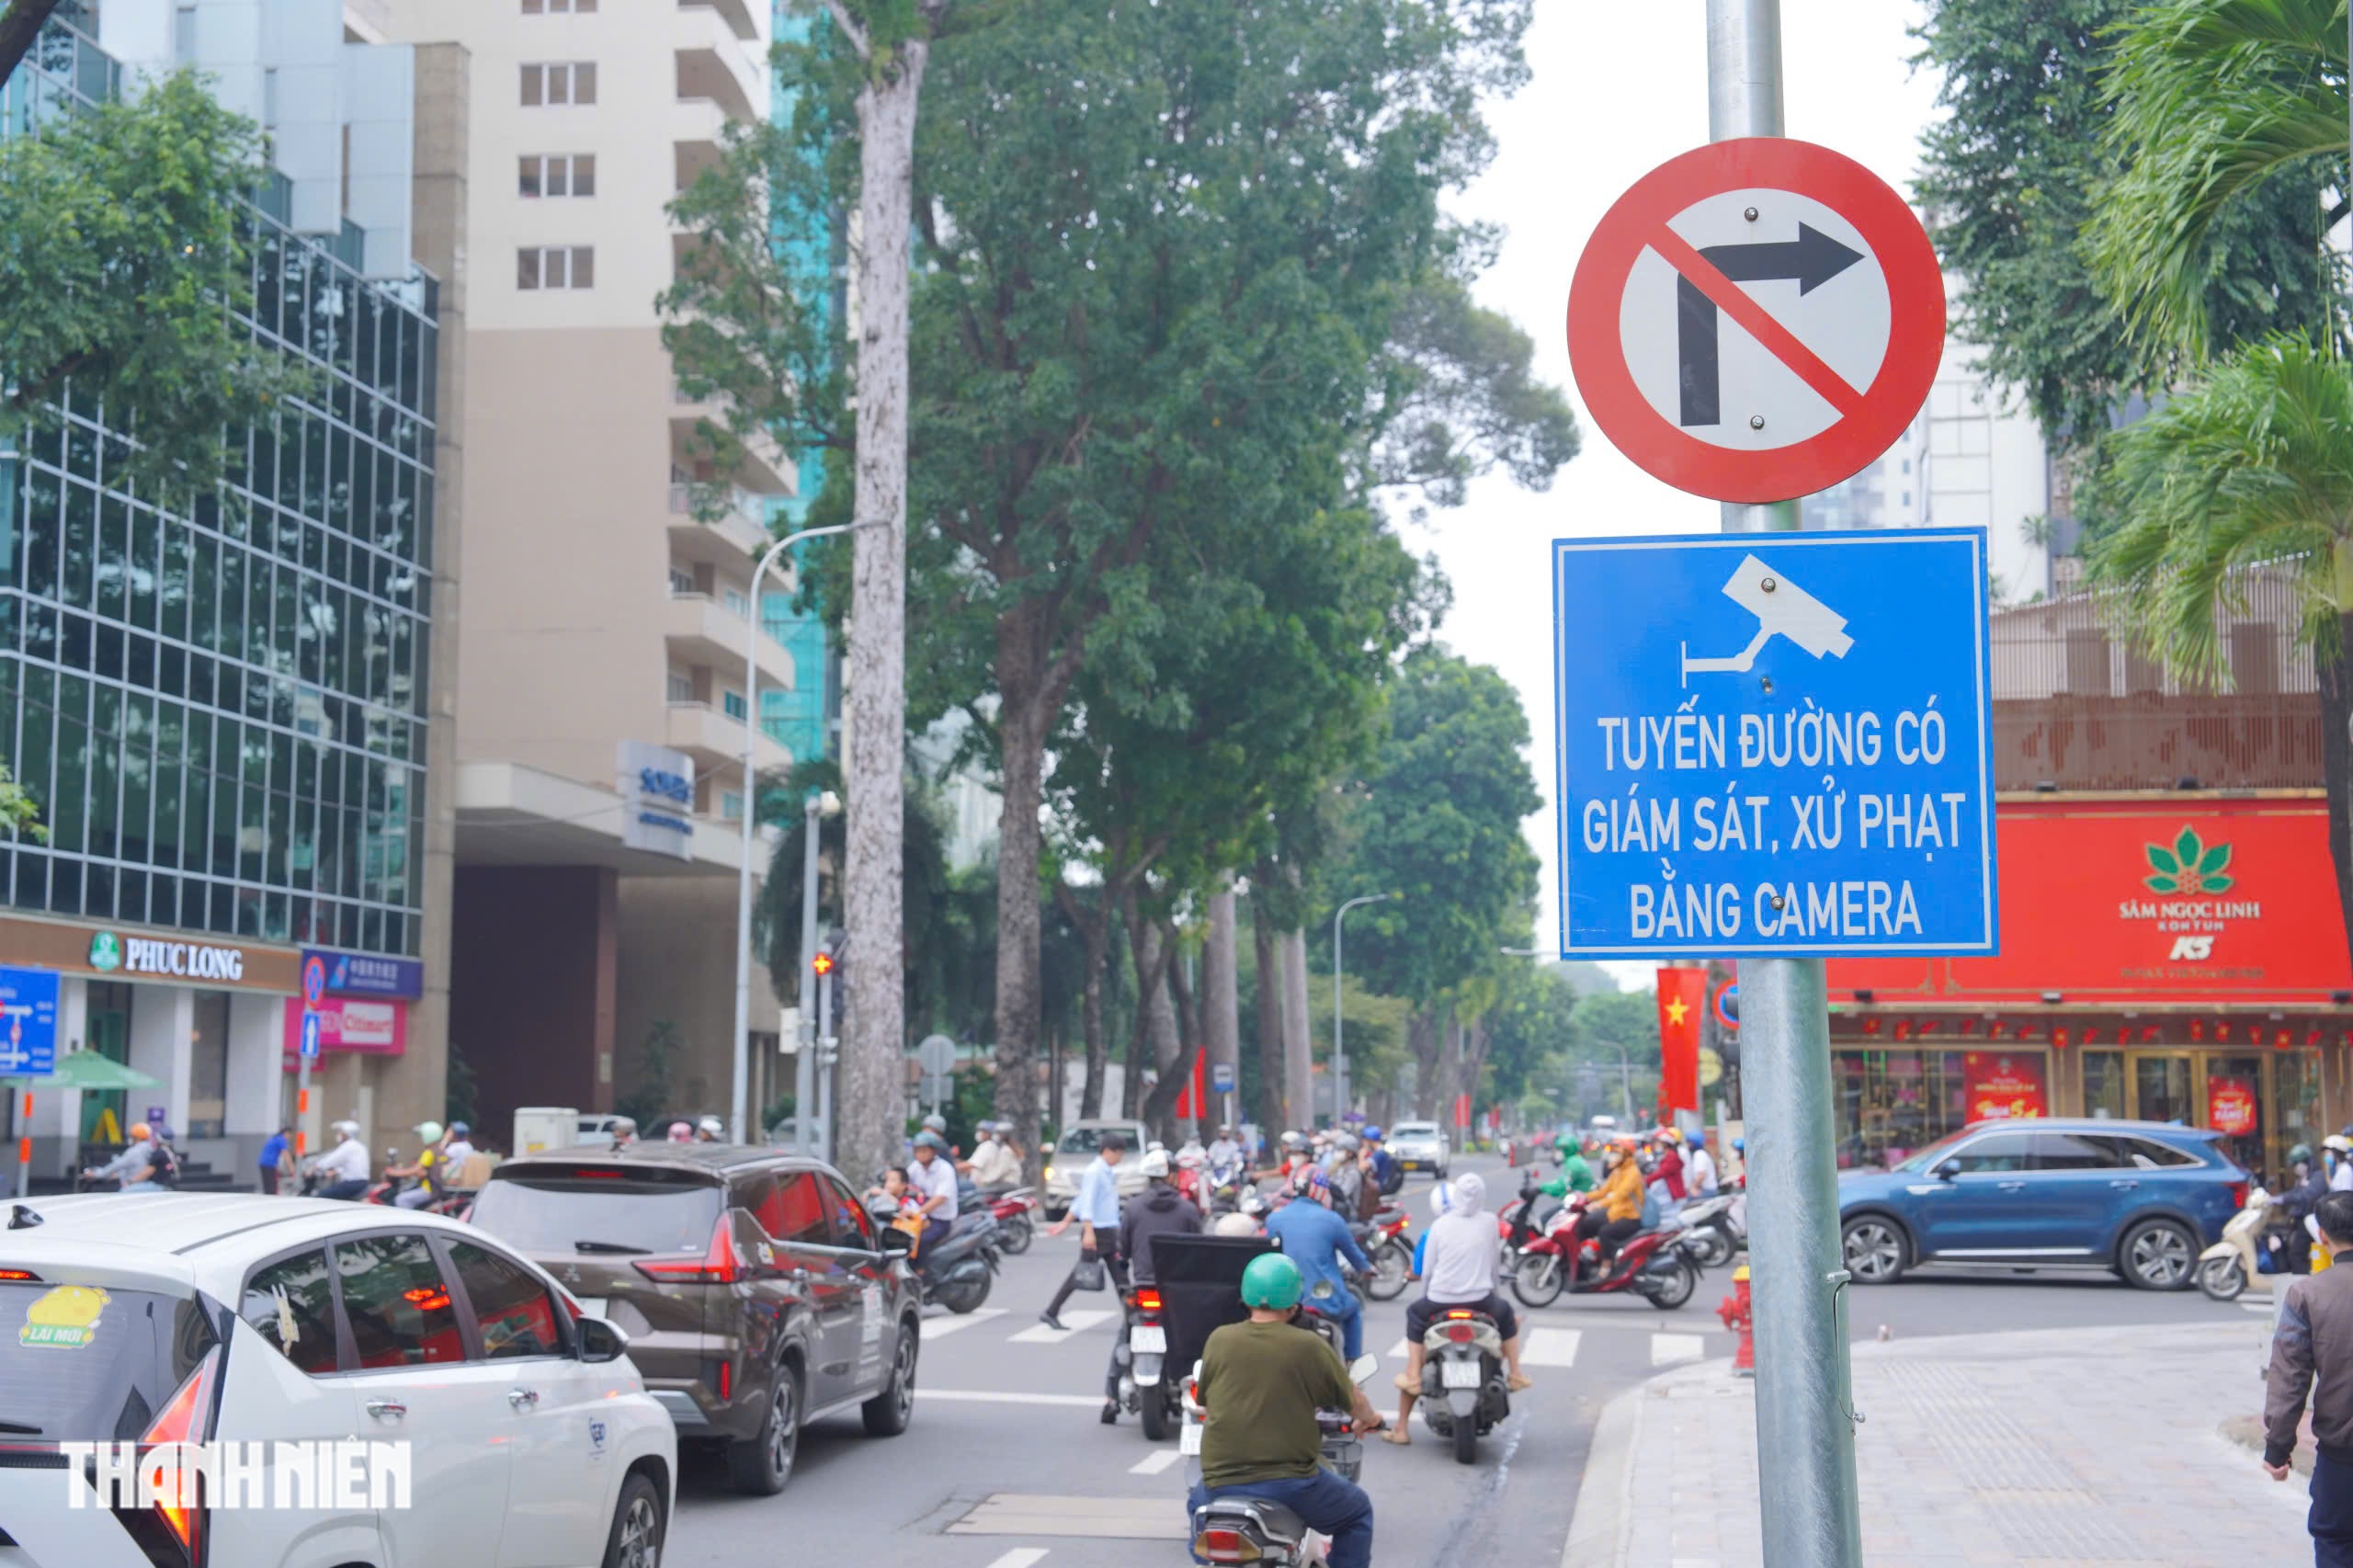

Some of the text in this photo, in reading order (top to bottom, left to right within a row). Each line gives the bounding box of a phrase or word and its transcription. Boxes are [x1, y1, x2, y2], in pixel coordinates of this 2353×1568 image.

[1597, 694, 1947, 770] TUYẾN ĐƯỜNG CÓ
[1583, 774, 1966, 862] GIÁM SÁT, XỬ PHẠT
[1631, 857, 1923, 938] BẰNG CAMERA
[2216, 902, 2261, 919] LINH
[187, 944, 244, 982] LONG
